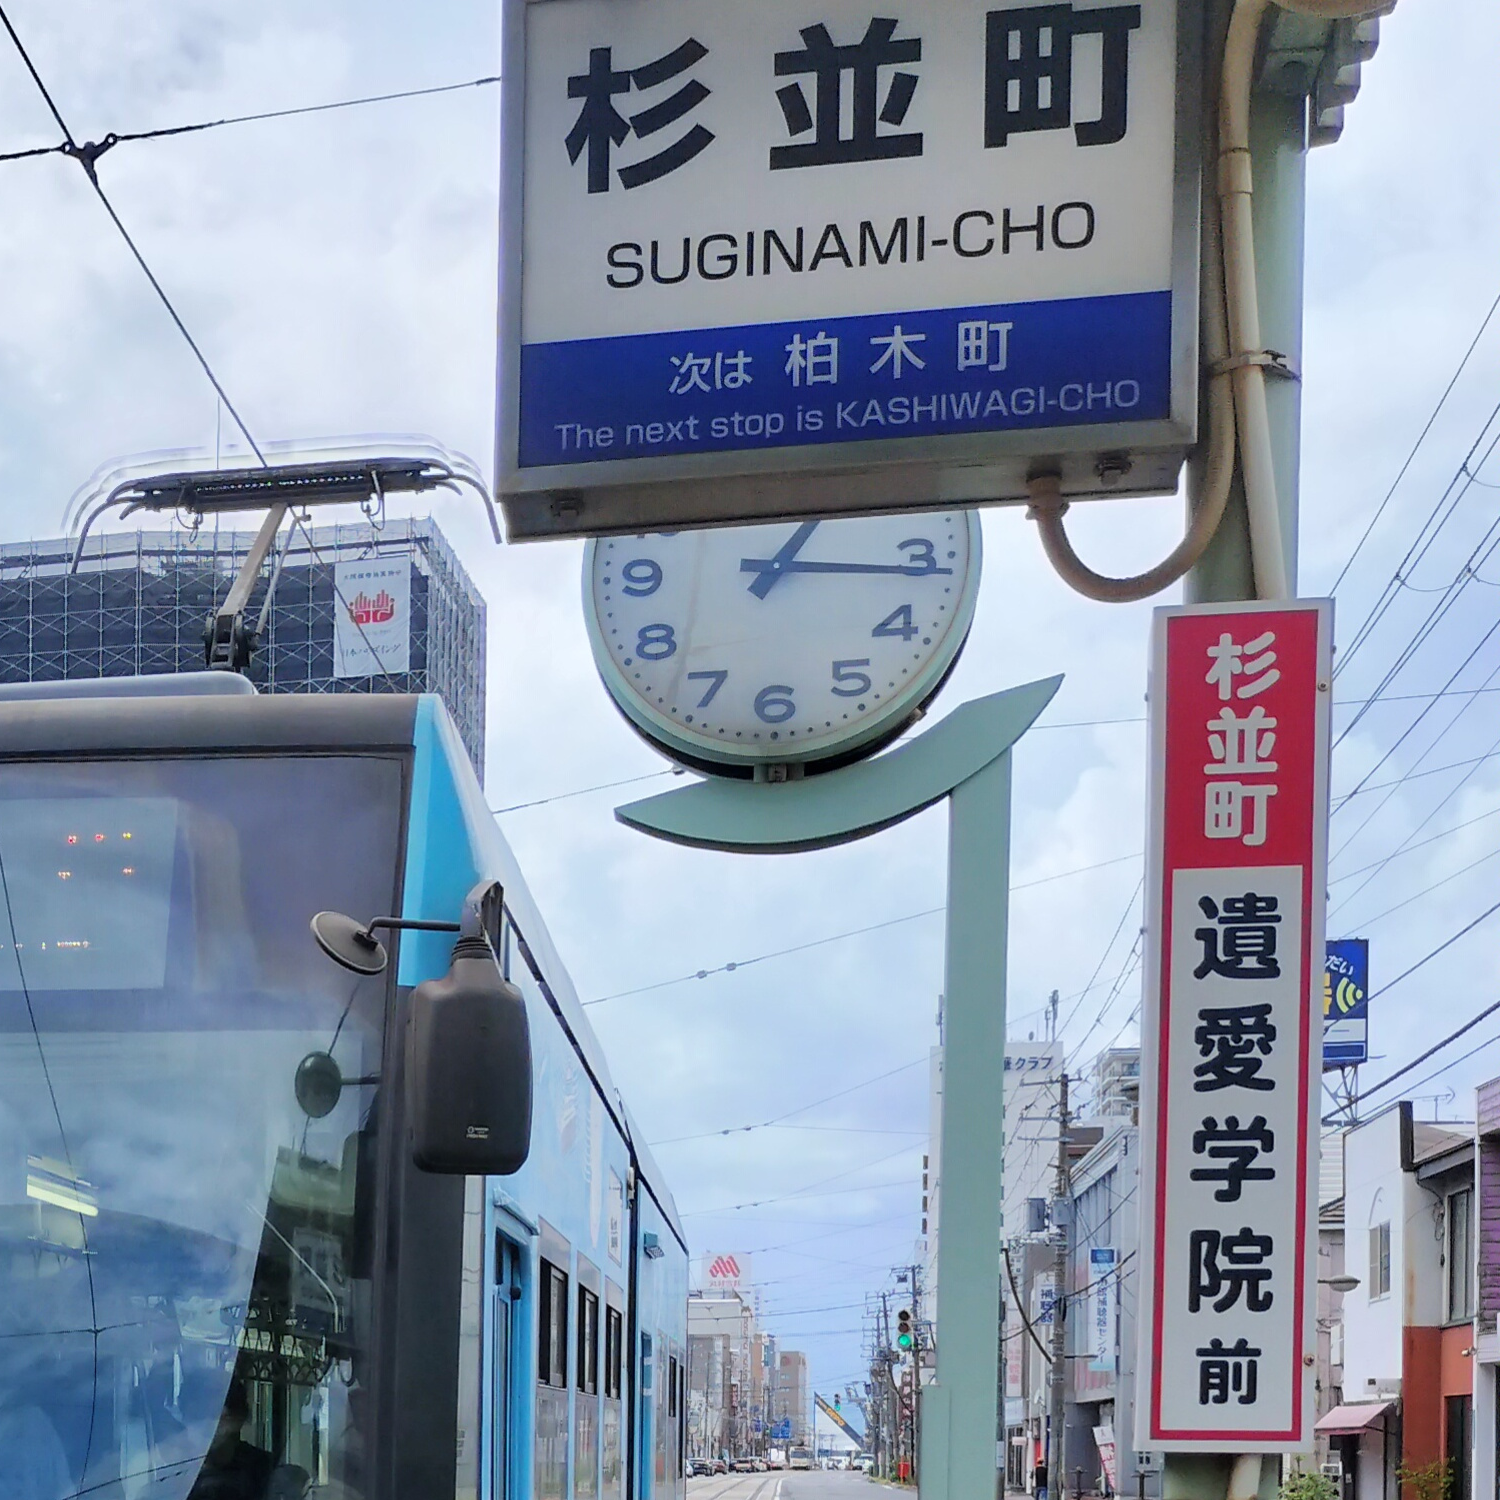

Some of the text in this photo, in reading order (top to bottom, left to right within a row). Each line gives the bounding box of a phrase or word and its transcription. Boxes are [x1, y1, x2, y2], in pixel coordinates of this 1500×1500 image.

[563, 4, 1142, 194] 杉並町
[606, 201, 1096, 289] SUGINAMI-CHO
[668, 320, 1014, 396] 次は 柏木町
[555, 379, 1141, 451] The next stop is KASHIWAGI-CHO
[897, 537, 938, 577] 3
[621, 558, 663, 598] 9
[636, 623, 677, 660] 8
[871, 605, 918, 641] 4
[687, 669, 728, 708] 7
[830, 658, 871, 697] 5
[753, 685, 796, 723] 6
[1203, 630, 1282, 847] 杉並町
[1325, 954, 1354, 976] だい
[1188, 891, 1283, 1407] 遺愛学院前
